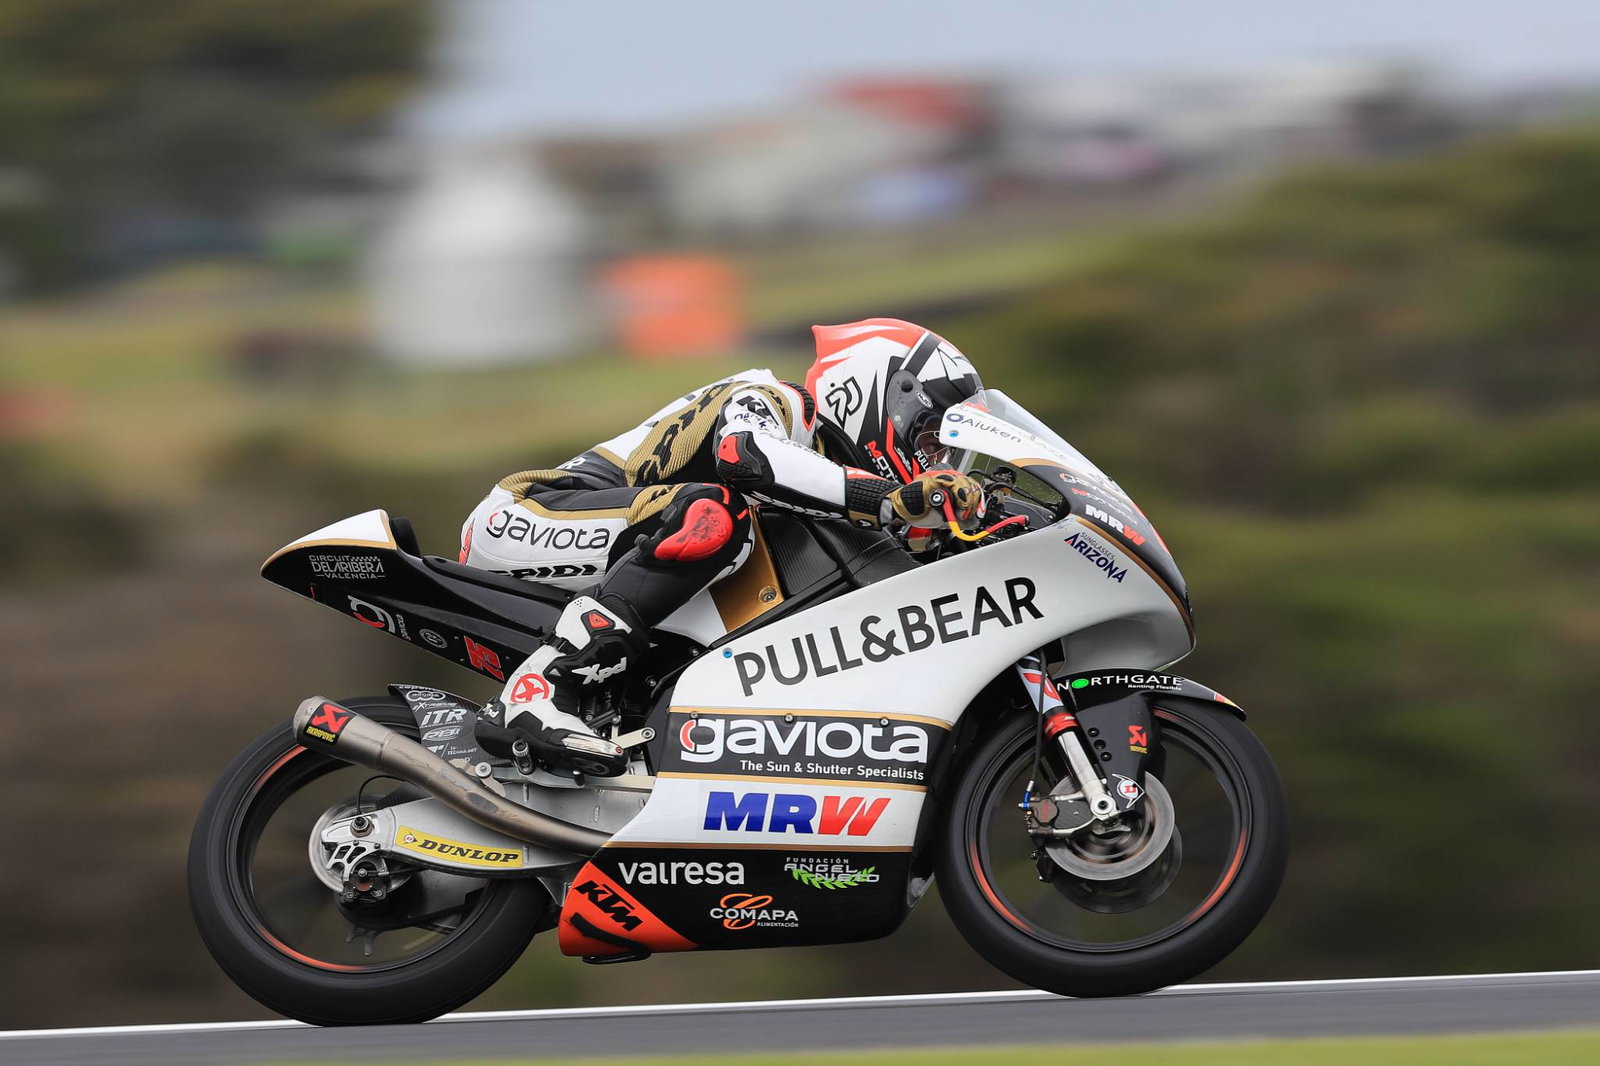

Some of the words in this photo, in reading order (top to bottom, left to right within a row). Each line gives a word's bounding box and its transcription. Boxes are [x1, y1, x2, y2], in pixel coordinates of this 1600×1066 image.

[486, 509, 611, 551] gaviota
[1085, 503, 1146, 546] MRW
[308, 554, 351, 562] CIRCUIT
[1064, 532, 1129, 584] ARIZONA
[733, 576, 1045, 698] PULL&BEAR
[678, 718, 930, 764] gaviota
[740, 760, 763, 772] The
[766, 761, 789, 774] Sun
[794, 763, 803, 773] &
[806, 763, 854, 776] Shutter
[857, 765, 924, 781] Specialists
[703, 791, 891, 837] MRW
[418, 838, 519, 864] DUNLOP
[786, 856, 849, 864] FUNDACIÓN
[617, 861, 745, 886] valresa
[574, 880, 643, 932] KTM
[709, 907, 799, 922] COMAPA
